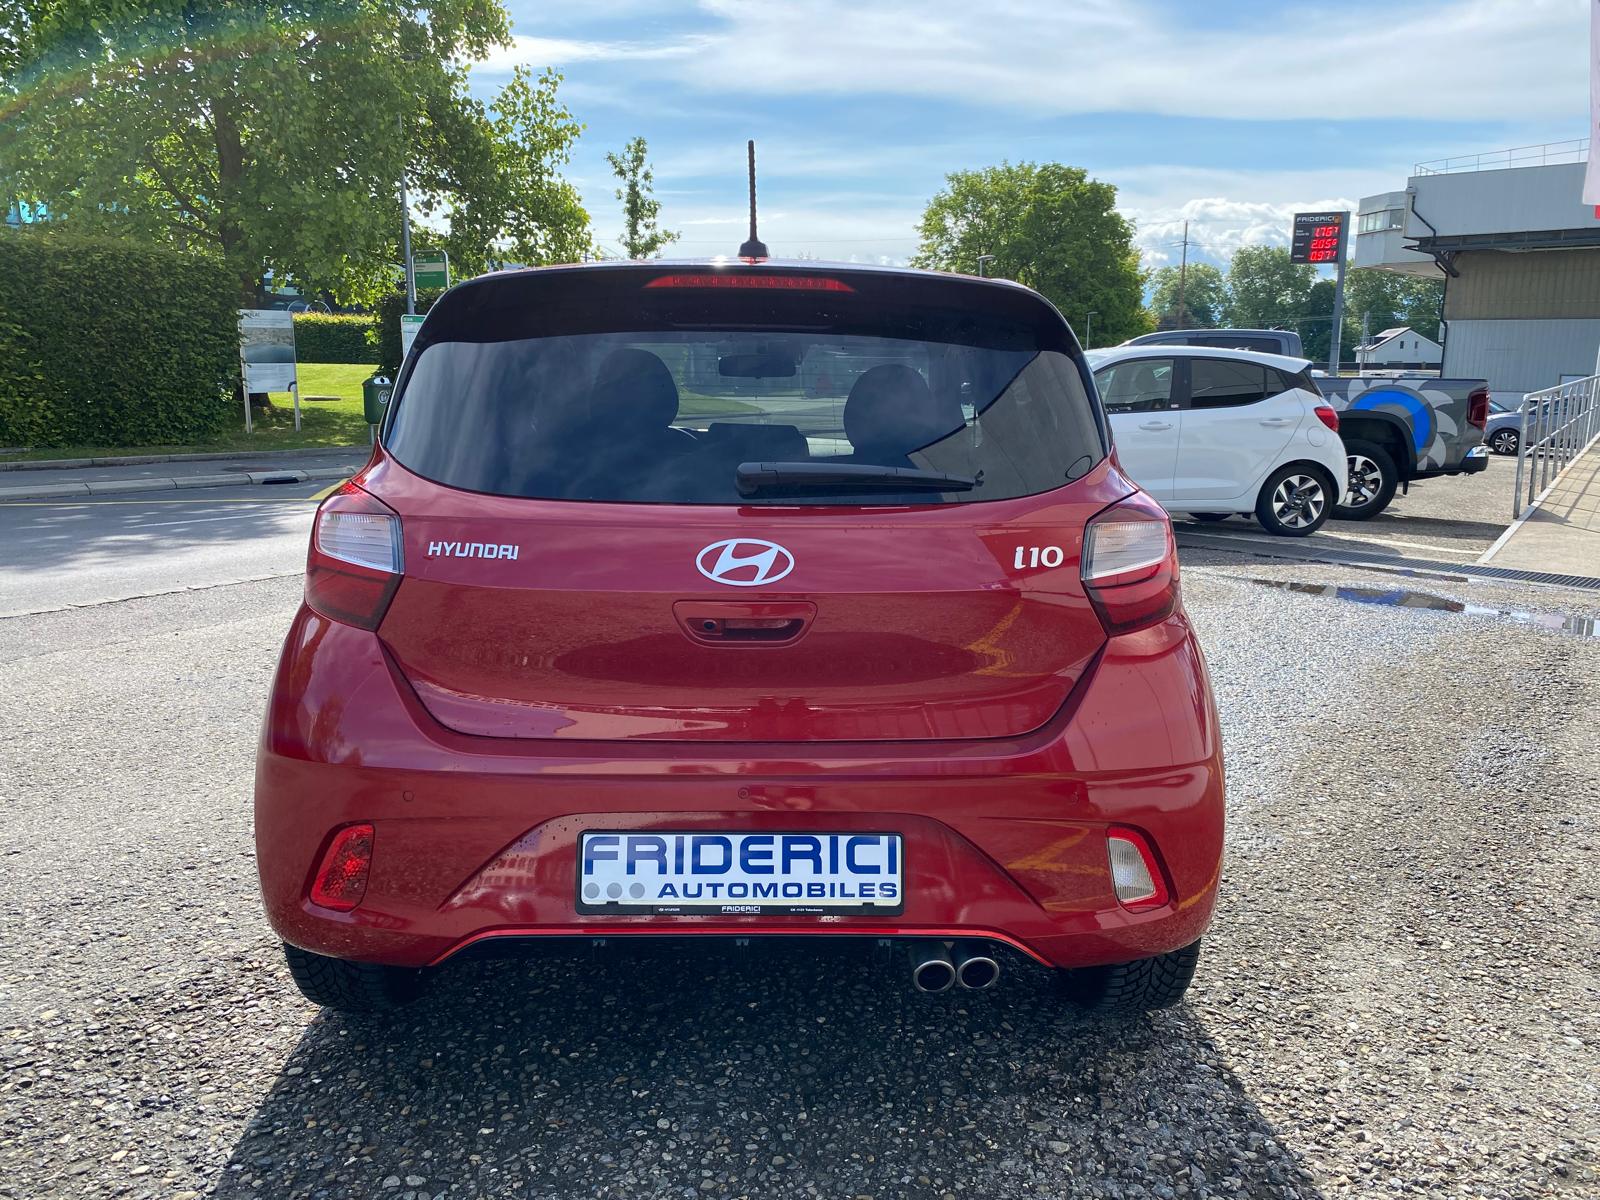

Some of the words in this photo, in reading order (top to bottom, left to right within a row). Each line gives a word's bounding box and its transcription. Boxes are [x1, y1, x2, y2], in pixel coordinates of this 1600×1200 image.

[428, 541, 519, 560] HYUNDAI
[1014, 546, 1064, 569] i10
[583, 835, 898, 875] FRIDERICI
[657, 882, 898, 898] AUTOMOBILES
